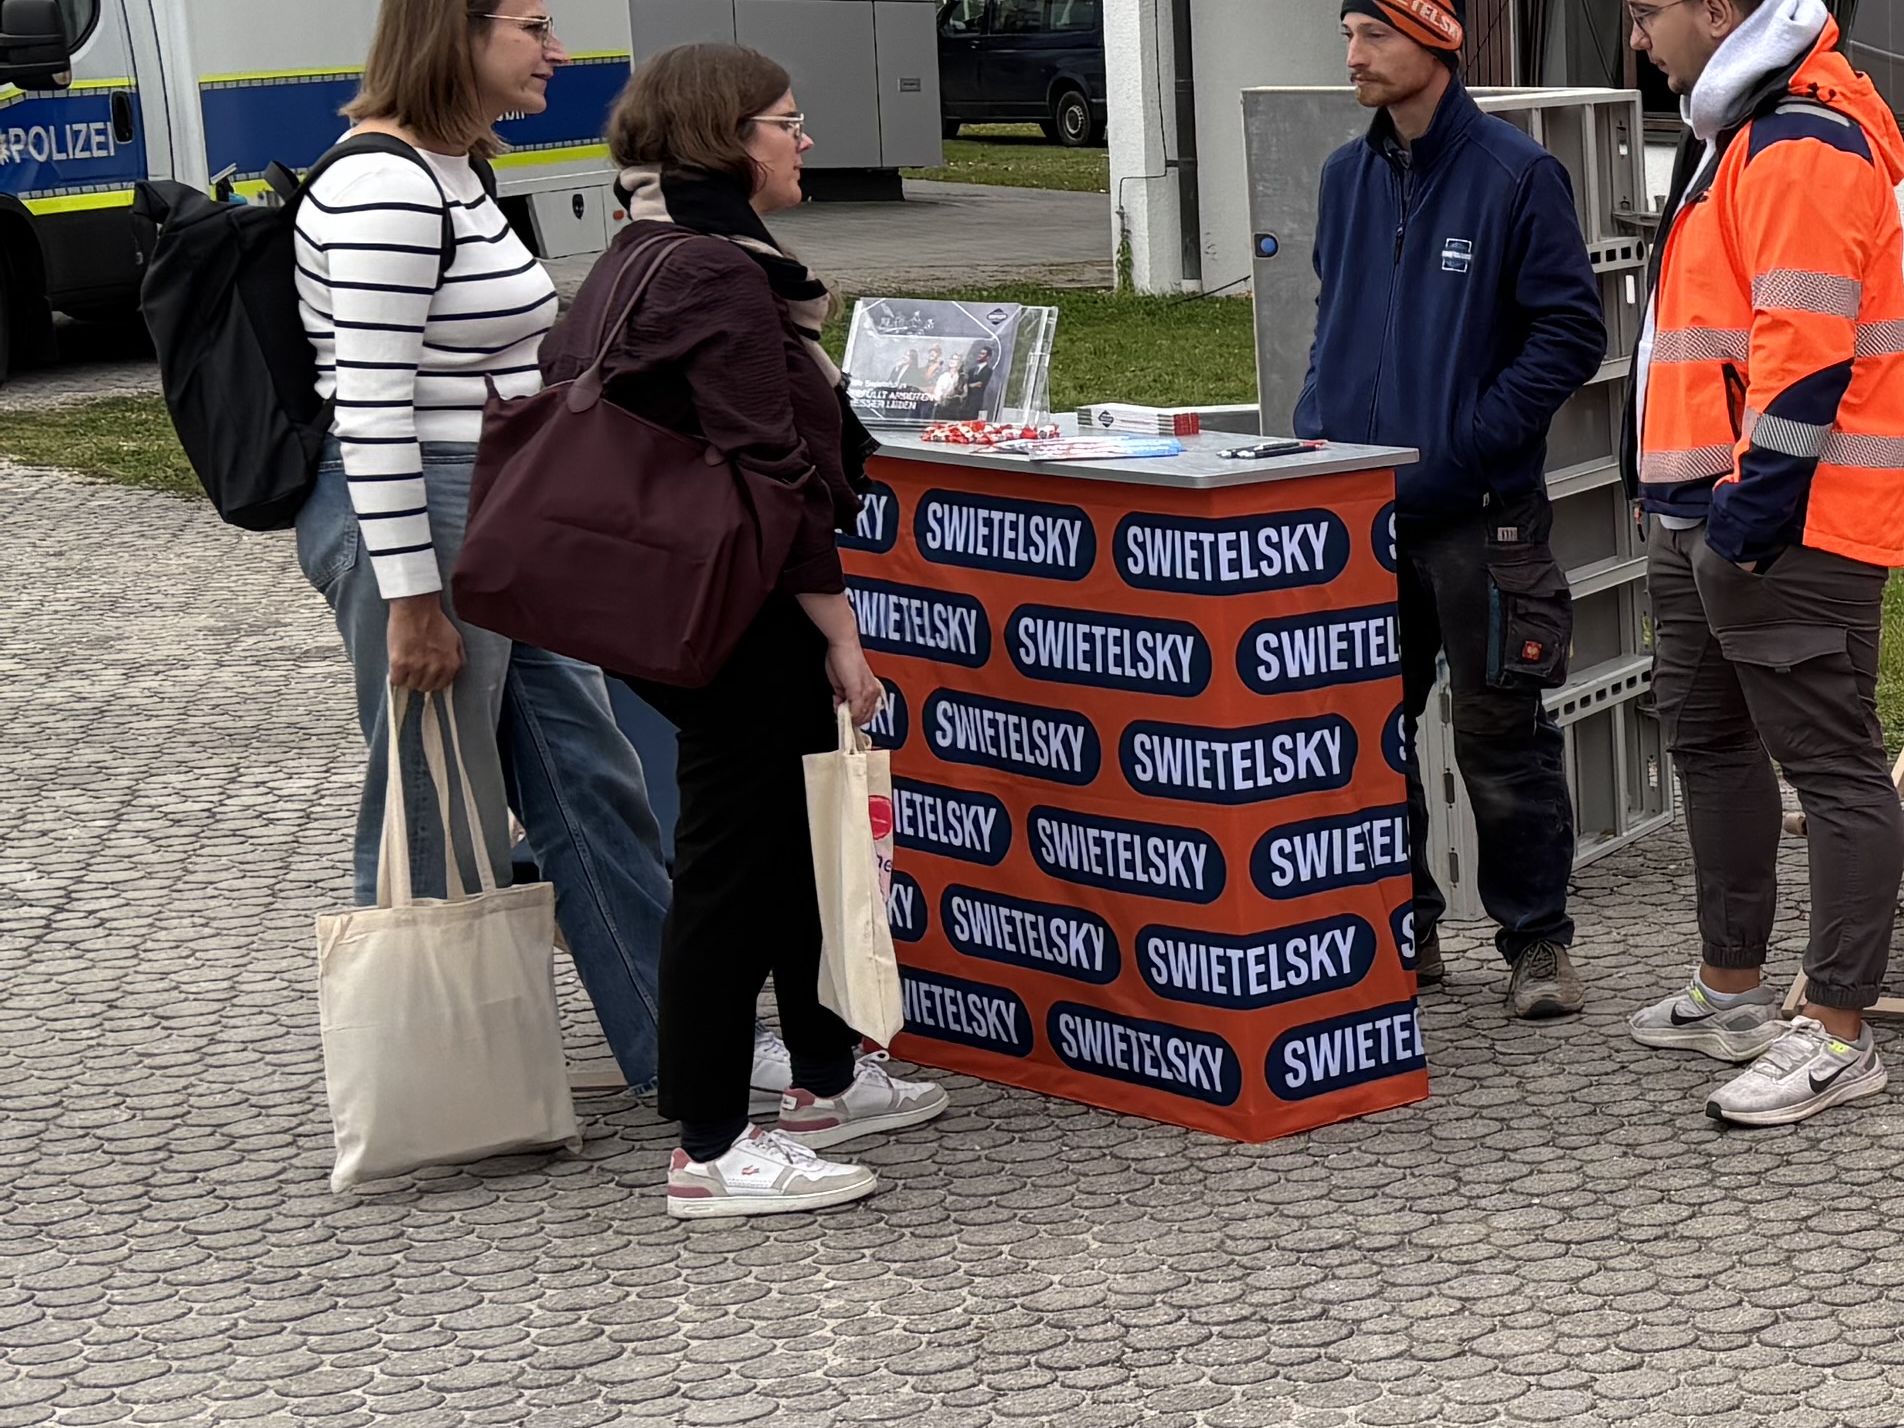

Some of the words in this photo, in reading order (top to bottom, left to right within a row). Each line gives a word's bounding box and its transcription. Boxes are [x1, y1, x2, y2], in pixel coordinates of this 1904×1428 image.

[8, 121, 115, 164] POLIZEI
[927, 502, 1081, 566] SWIETELSKY
[1128, 522, 1328, 581] SWIETELSKY
[1019, 617, 1194, 683] SWIETELSKY
[1256, 616, 1401, 681] SWIETEL
[936, 701, 1084, 772] SWIETELSKY
[1134, 727, 1340, 790] SWIETELSKY
[1038, 818, 1206, 889] SWIETELSKY
[1270, 817, 1411, 886] SWIETEL
[952, 897, 1103, 971] SWIETELSKY
[1148, 926, 1355, 995] SWIETELSKY
[1060, 1014, 1223, 1092] SWIETELSKY
